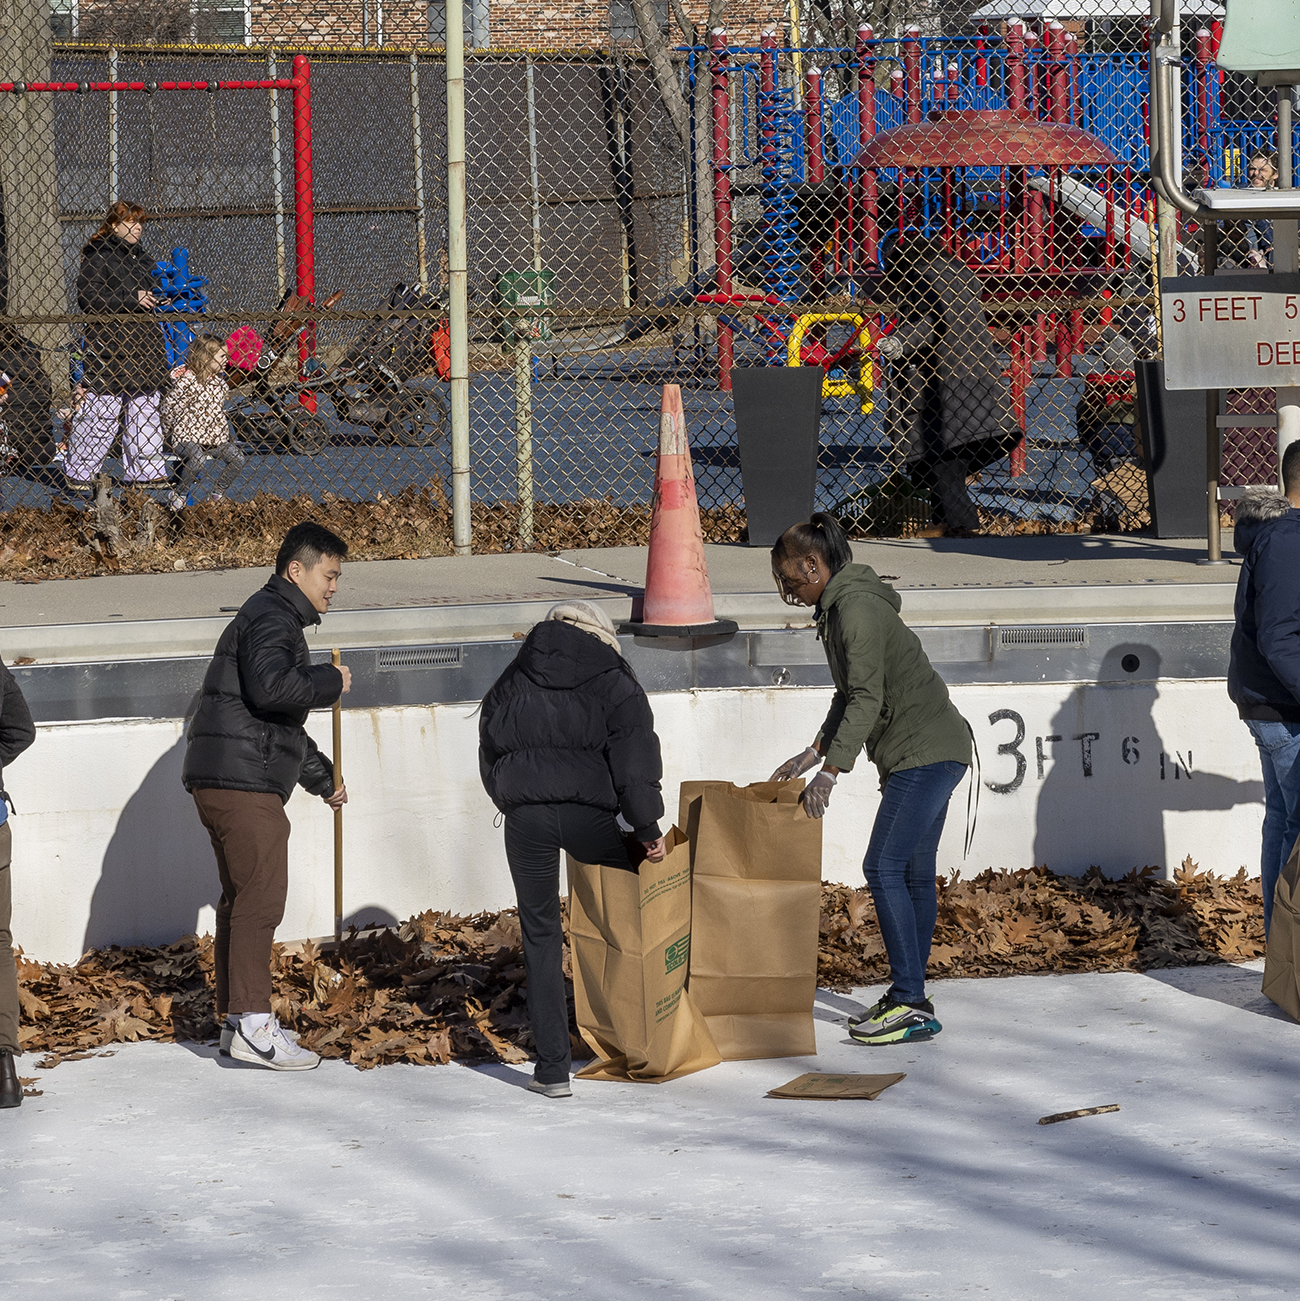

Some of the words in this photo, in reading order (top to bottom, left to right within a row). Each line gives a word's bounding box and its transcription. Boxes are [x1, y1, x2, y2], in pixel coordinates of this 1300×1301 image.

[1172, 299, 1186, 322] 3
[1199, 296, 1263, 322] FEET
[1284, 295, 1298, 319] 5
[1121, 736, 1141, 765] 6
[1159, 750, 1193, 780] IN
